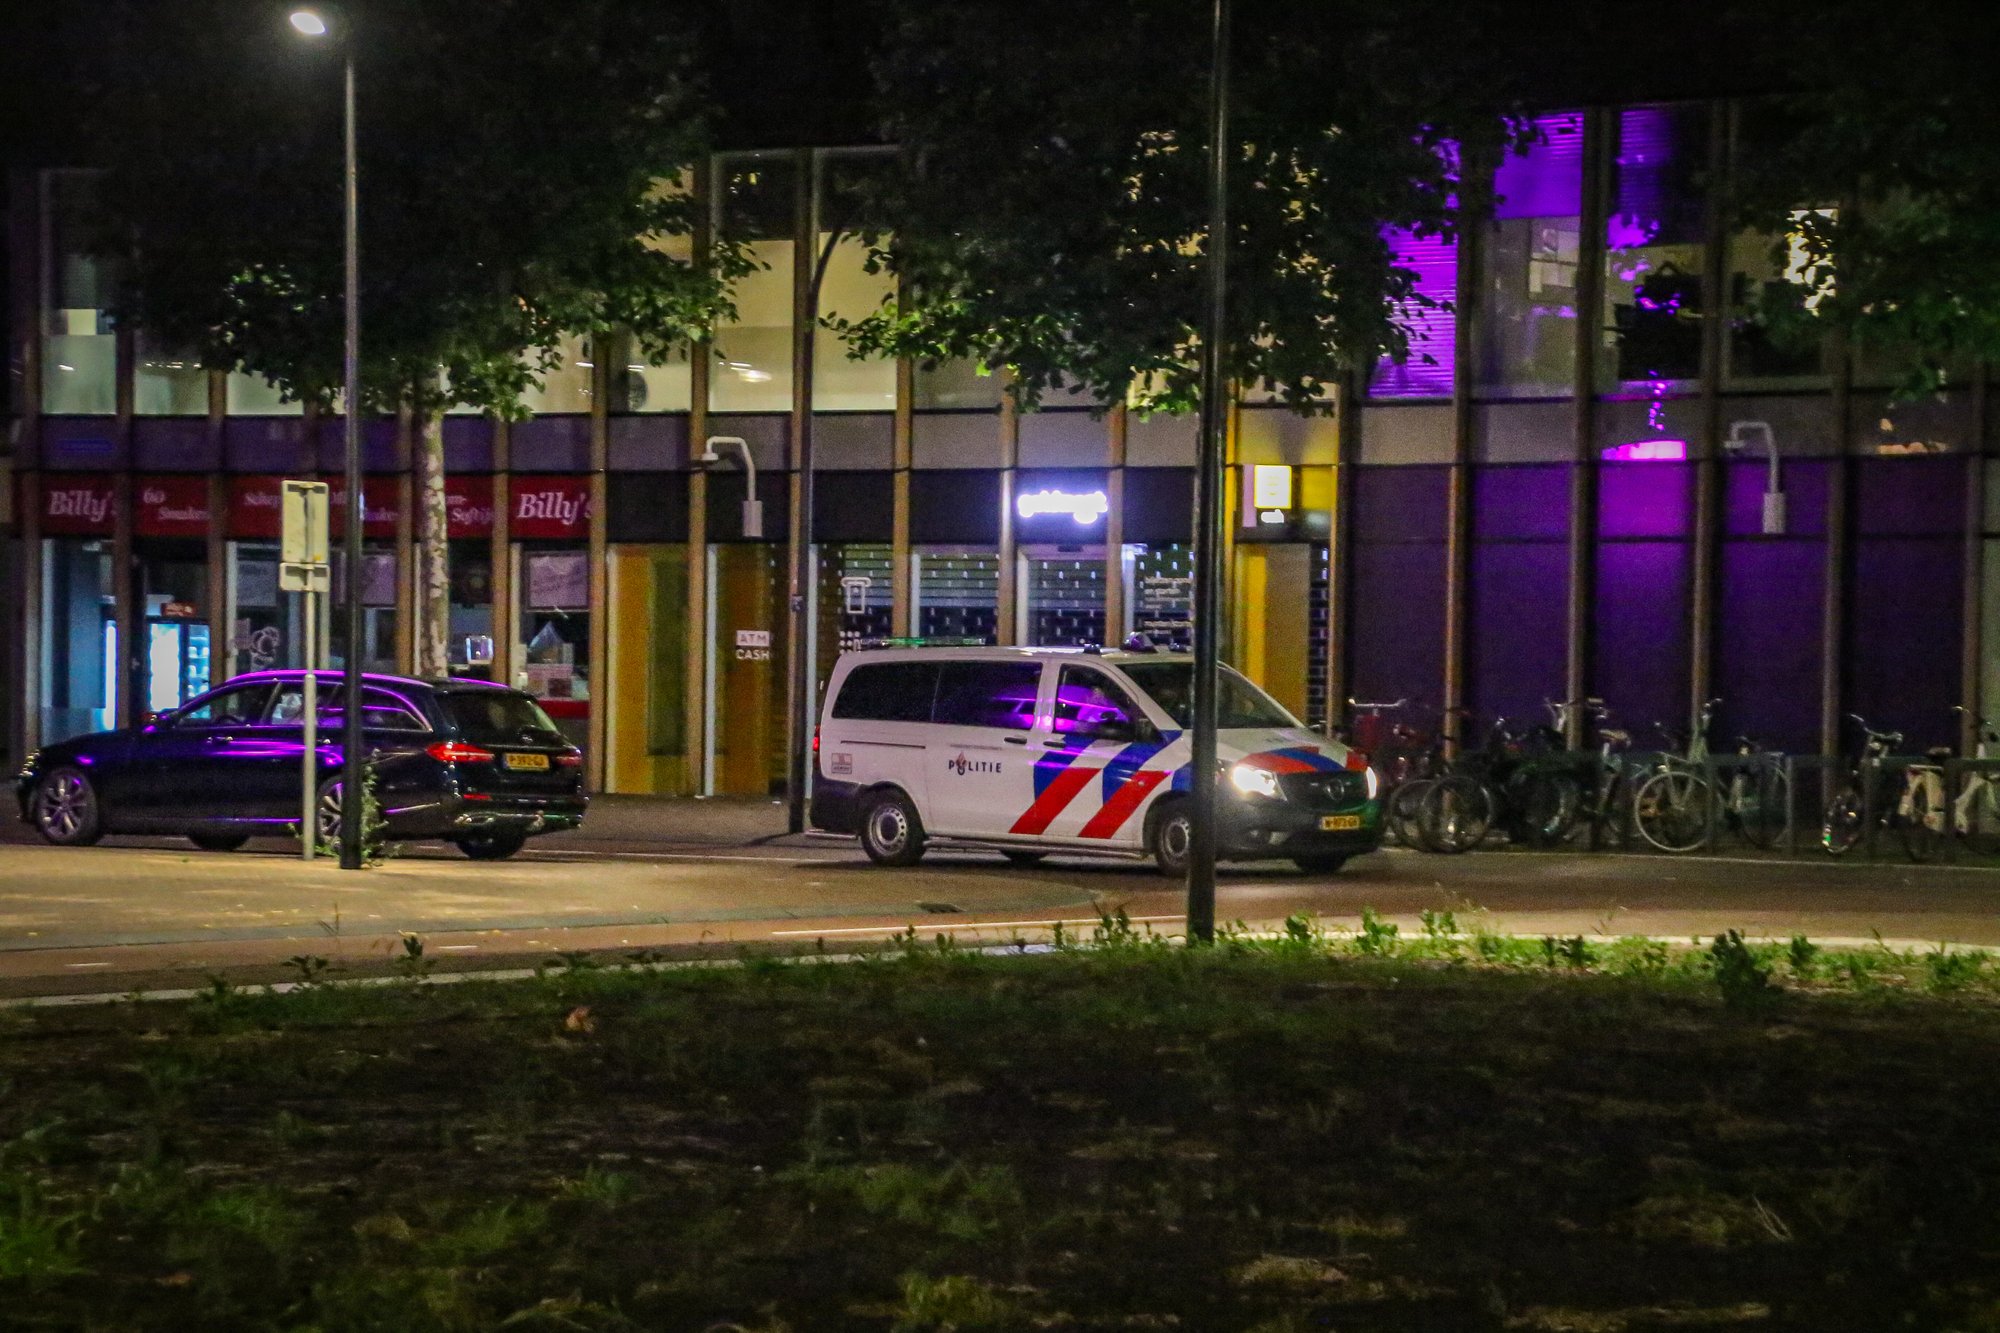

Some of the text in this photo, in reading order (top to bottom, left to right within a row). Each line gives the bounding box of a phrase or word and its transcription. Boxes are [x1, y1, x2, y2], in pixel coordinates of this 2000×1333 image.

[740, 633, 768, 645] ATM
[735, 648, 770, 660] CASH
[948, 758, 1002, 776] POLITIE
